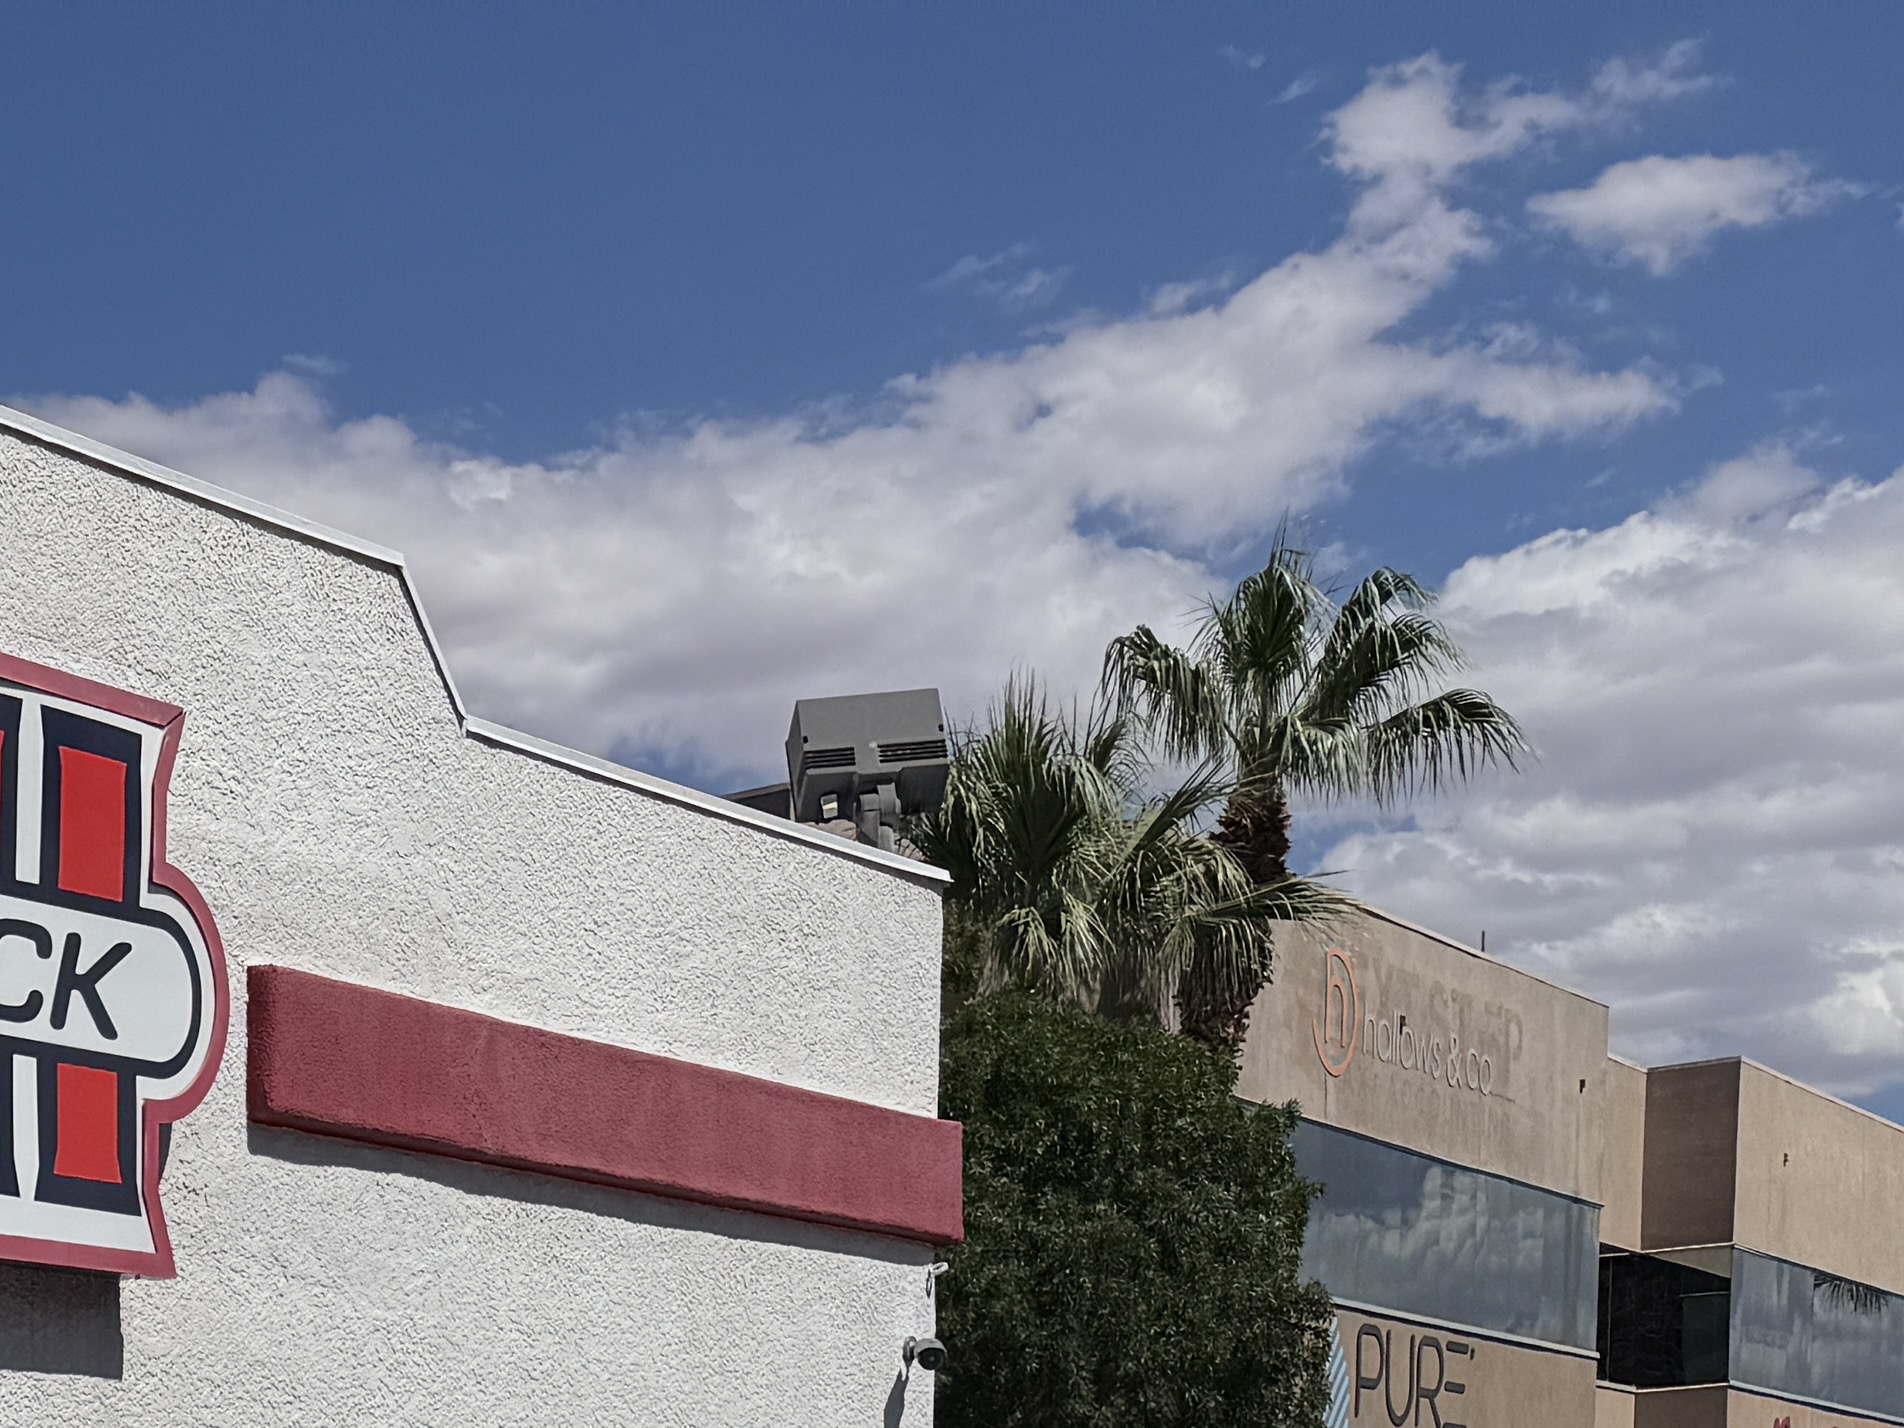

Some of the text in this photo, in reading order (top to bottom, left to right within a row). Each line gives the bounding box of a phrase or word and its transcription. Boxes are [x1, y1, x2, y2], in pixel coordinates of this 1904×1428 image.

[1361, 999, 1442, 1080] hallows
[1446, 1032, 1463, 1088] &
[1466, 1047, 1493, 1096] co
